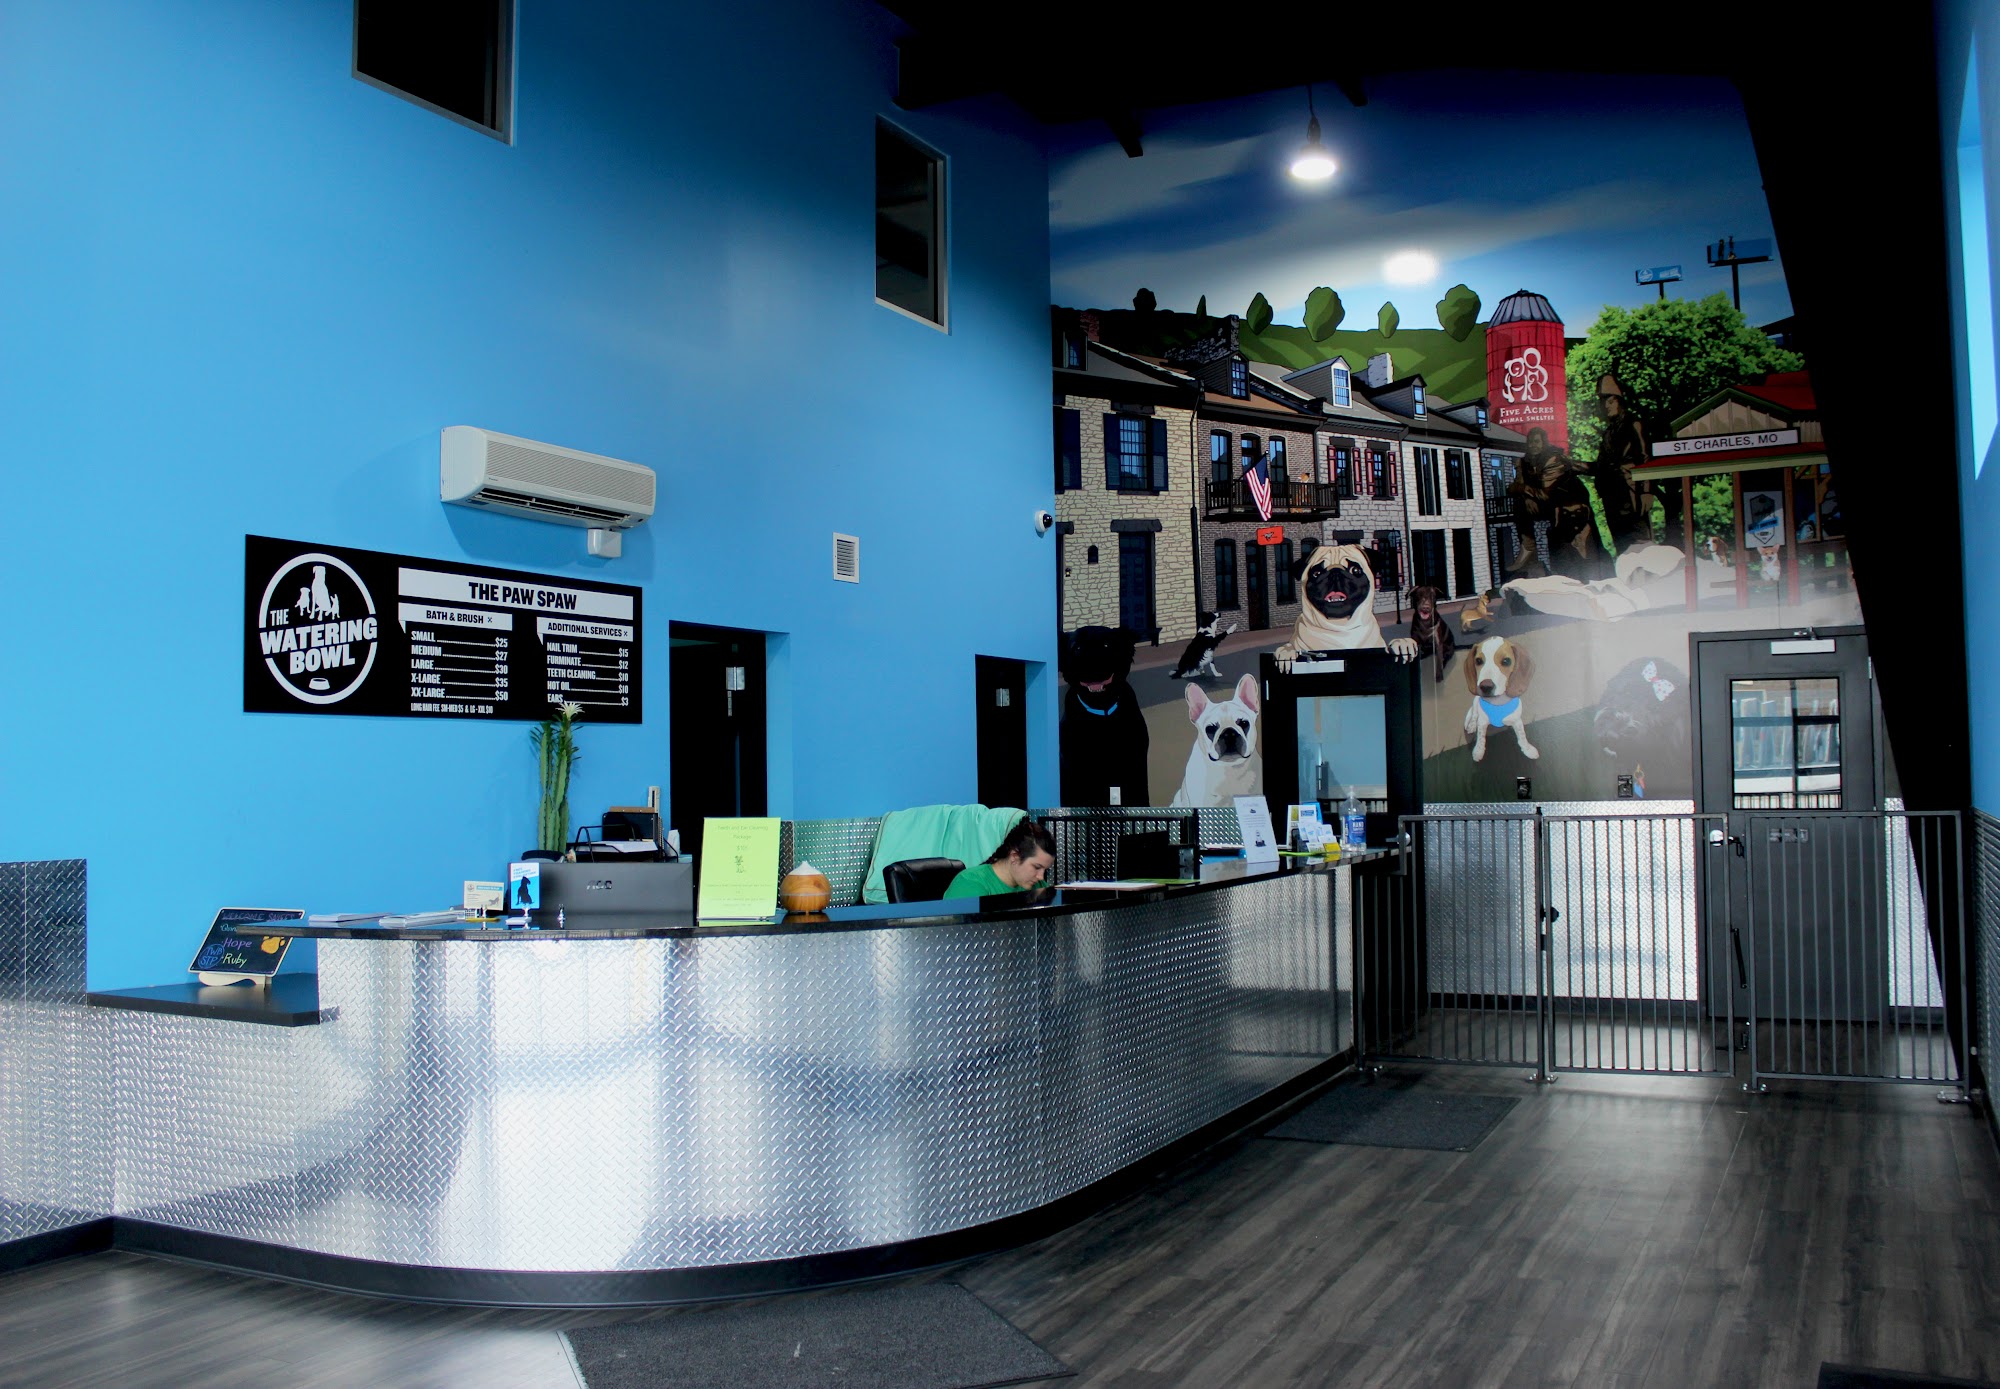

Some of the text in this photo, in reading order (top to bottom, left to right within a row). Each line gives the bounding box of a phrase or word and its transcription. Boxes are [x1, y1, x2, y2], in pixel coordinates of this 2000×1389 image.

[1673, 433, 1778, 452] ST. CHARLES, MO
[468, 582, 577, 610] THE PAW SPAW
[270, 608, 290, 627] THE
[426, 610, 484, 624] BATH & BRUSH
[259, 617, 378, 655] WATERING
[547, 622, 622, 637] ADDITIONAL SERVICES
[411, 630, 508, 648] SMALL $25
[411, 644, 508, 661] MEDIUM $27
[547, 642, 629, 658] NAIL TRIM $15
[289, 643, 356, 675] BOWL
[547, 655, 629, 670] FURMINATE $12
[411, 659, 508, 675] LARGE $30
[411, 673, 508, 688] X-LARGE $35
[547, 668, 629, 682] TEETH CLEANING $10
[411, 687, 508, 701] XX-LARGE $50
[547, 681, 629, 694] HOT OIL $10
[547, 694, 629, 706] EARS $3
[411, 703, 422, 711] LONG
[464, 705, 469, 713] &
[223, 937, 253, 950] Hope
[200, 957, 218, 966] STP
[222, 953, 248, 968] Ruby
